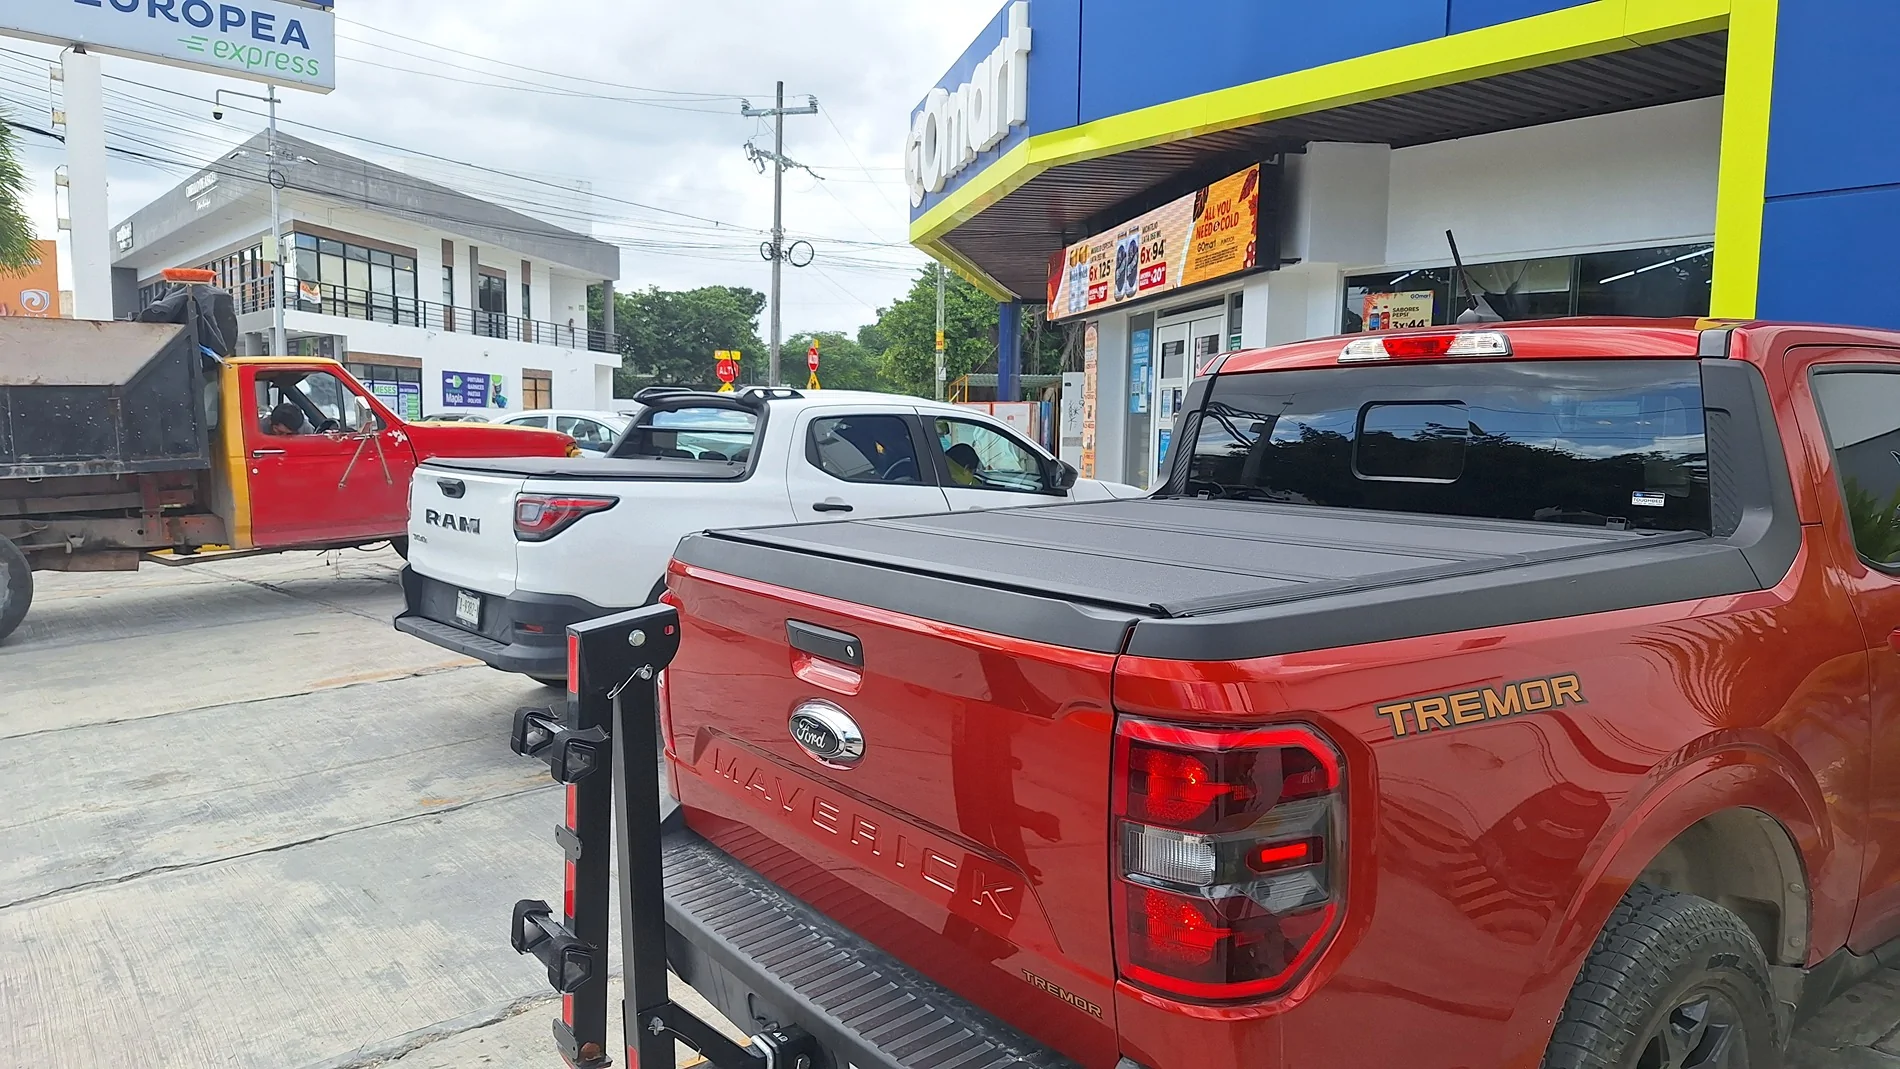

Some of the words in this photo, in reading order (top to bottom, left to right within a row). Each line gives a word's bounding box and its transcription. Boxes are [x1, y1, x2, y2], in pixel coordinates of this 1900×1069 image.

[75, 0, 310, 50] ROPEA
[213, 38, 320, 77] express
[1196, 221, 1213, 240] NEED
[1220, 212, 1239, 232] COLD
[1203, 206, 1216, 222] ALL
[1217, 199, 1231, 217] YOU
[1089, 265, 1098, 281] 6x
[374, 385, 397, 395] MESES
[425, 507, 481, 535] RAM
[1375, 672, 1586, 737] TREMOR
[796, 718, 827, 749] Ford
[713, 747, 1015, 921] MAVERICK
[1020, 967, 1104, 1020] TREMOR
